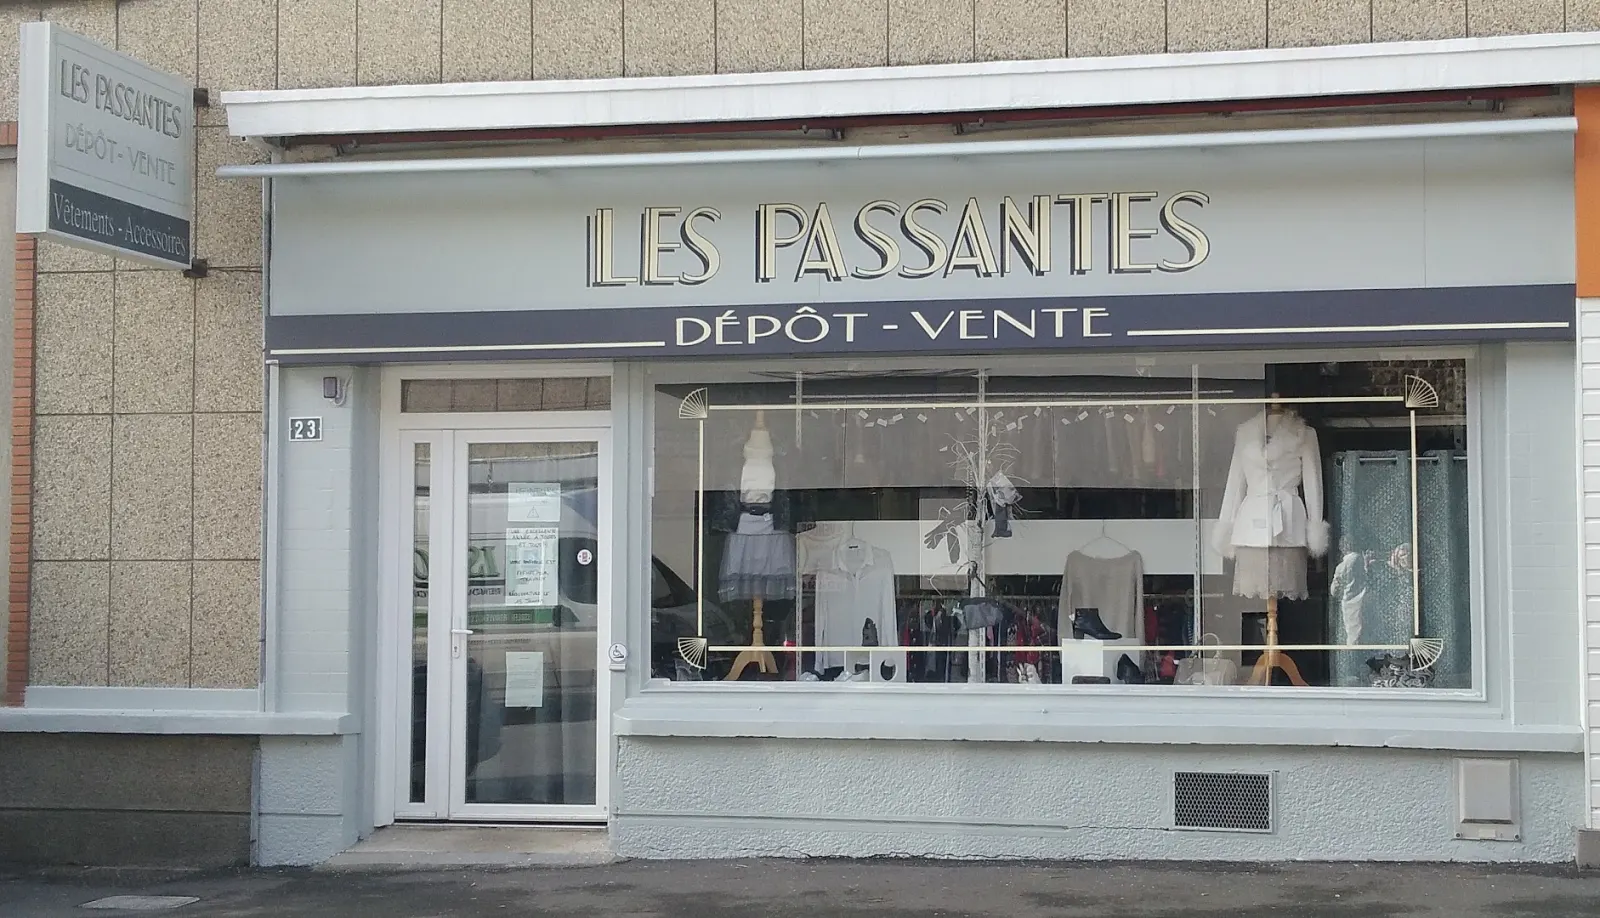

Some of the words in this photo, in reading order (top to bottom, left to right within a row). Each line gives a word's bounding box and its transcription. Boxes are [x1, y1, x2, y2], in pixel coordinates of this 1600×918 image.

[60, 58, 91, 104] LES
[95, 73, 182, 139] PASSANTES
[65, 122, 117, 164] DÉPÔT
[129, 146, 176, 186] VENTE
[54, 192, 115, 237] Vêtements
[124, 222, 187, 257] Accessoires
[586, 206, 722, 288] LES
[755, 190, 1211, 284] PASSANTES
[675, 309, 869, 346] DÉPÔT
[910, 307, 1113, 340] VENTE
[295, 420, 316, 438] 23
